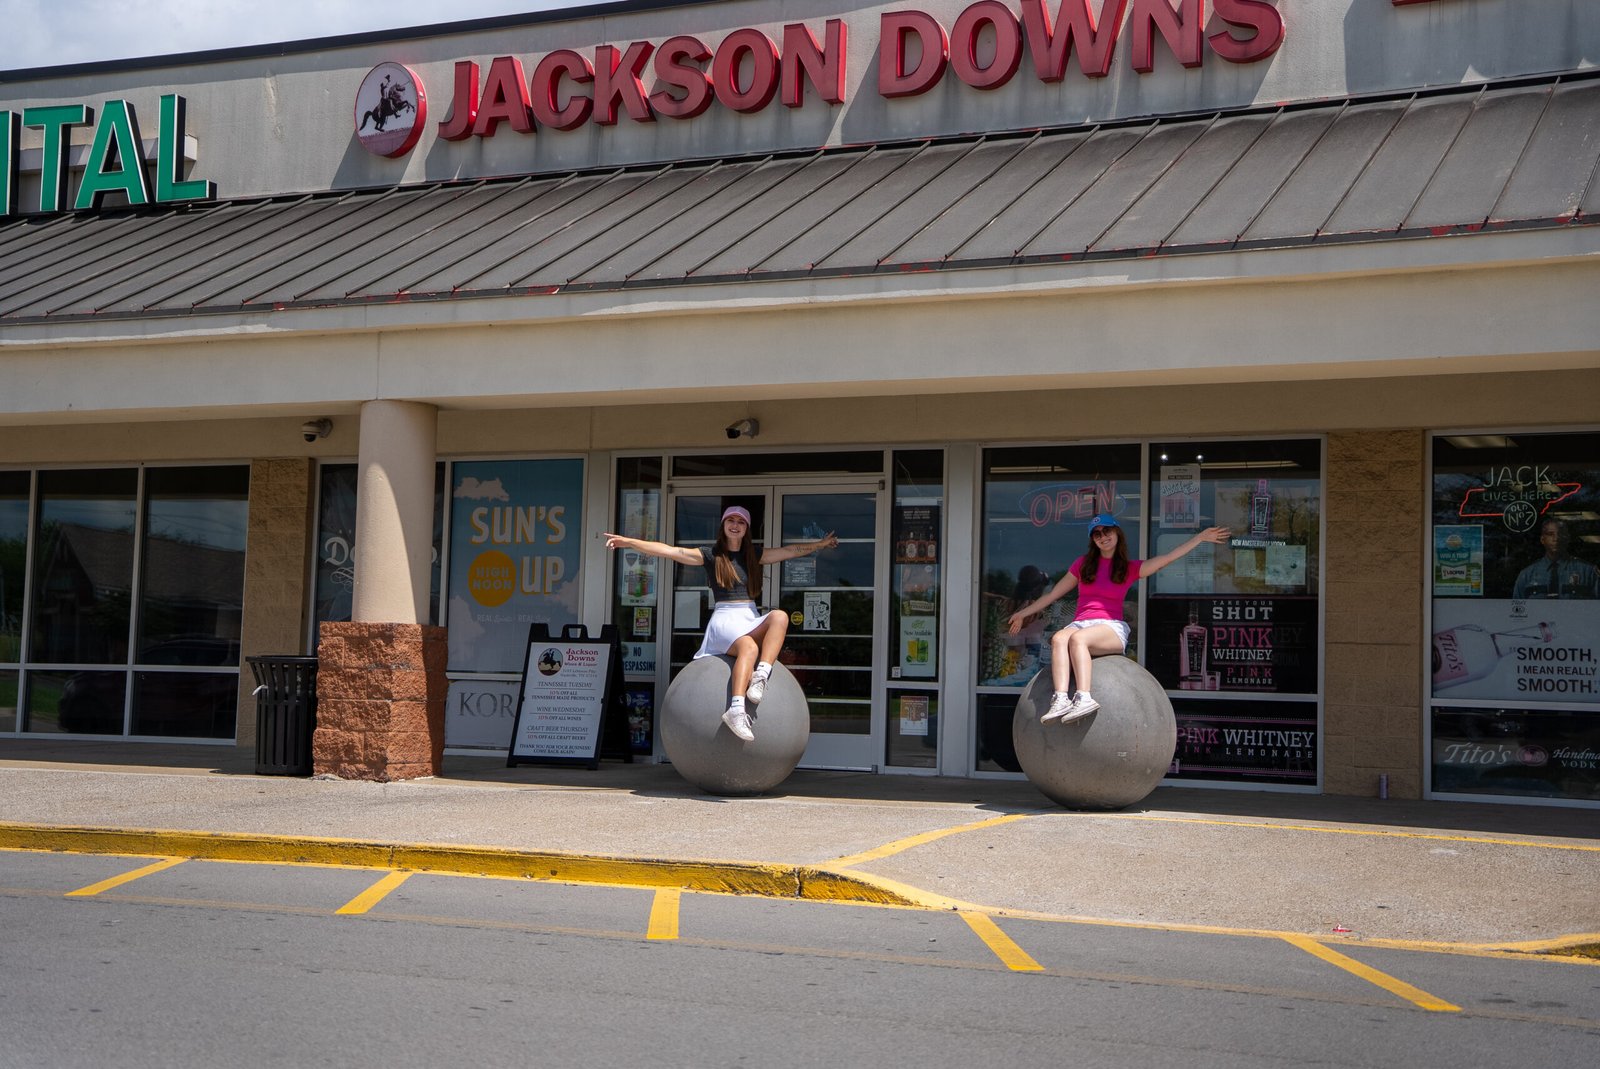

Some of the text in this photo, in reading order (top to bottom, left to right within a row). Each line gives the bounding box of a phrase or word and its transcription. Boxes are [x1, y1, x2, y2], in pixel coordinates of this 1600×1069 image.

[438, 0, 1286, 141] JACKSON DOWNS
[1482, 465, 1553, 488] JACK
[1482, 491, 1516, 502] LIVES
[1030, 480, 1116, 528] OPEN
[470, 505, 567, 545] SUN'S
[476, 567, 509, 578] HIGH
[520, 555, 565, 595] UP
[473, 579, 512, 590] NOON
[1212, 606, 1273, 620] SHOT
[1212, 626, 1273, 648] PINK
[565, 648, 599, 656] Jackson
[633, 646, 642, 657] NO
[1212, 648, 1273, 661] WHITNEY
[1438, 634, 1465, 673] Tito's
[624, 660, 656, 672] ESPASSING
[1226, 666, 1273, 677] PINK
[1523, 666, 1554, 675] MEAN
[1556, 666, 1597, 676] REALLY
[1226, 677, 1273, 685] LEMONADE
[457, 692, 515, 718] KOR
[1176, 727, 1315, 749] PINK WHITNEY
[1176, 745, 1313, 759] INK LEMONADE
[1444, 742, 1512, 765] Tito's
[1561, 761, 1597, 769] VODK
